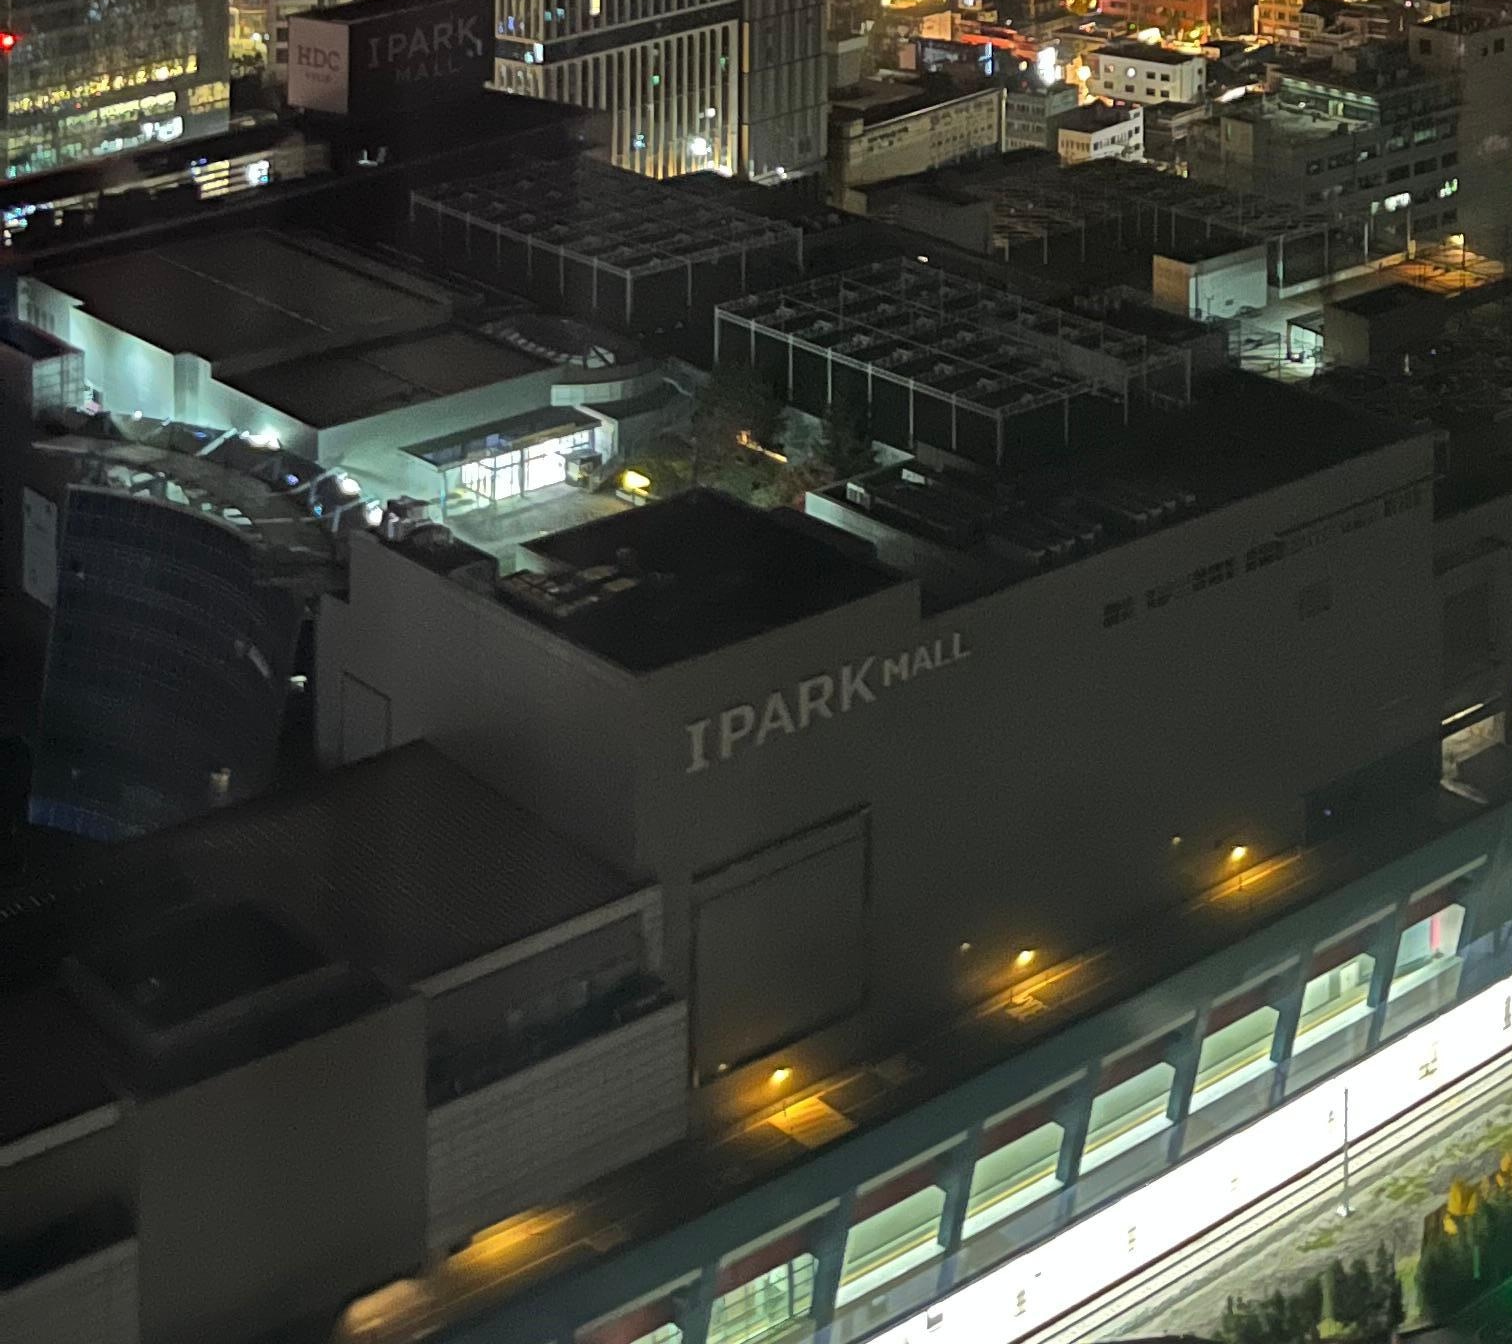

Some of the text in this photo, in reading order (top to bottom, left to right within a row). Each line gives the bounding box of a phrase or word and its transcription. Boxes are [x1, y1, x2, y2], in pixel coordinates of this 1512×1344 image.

[297, 44, 341, 72] HDC
[396, 55, 464, 82] MALL
[882, 632, 972, 687] MALL
